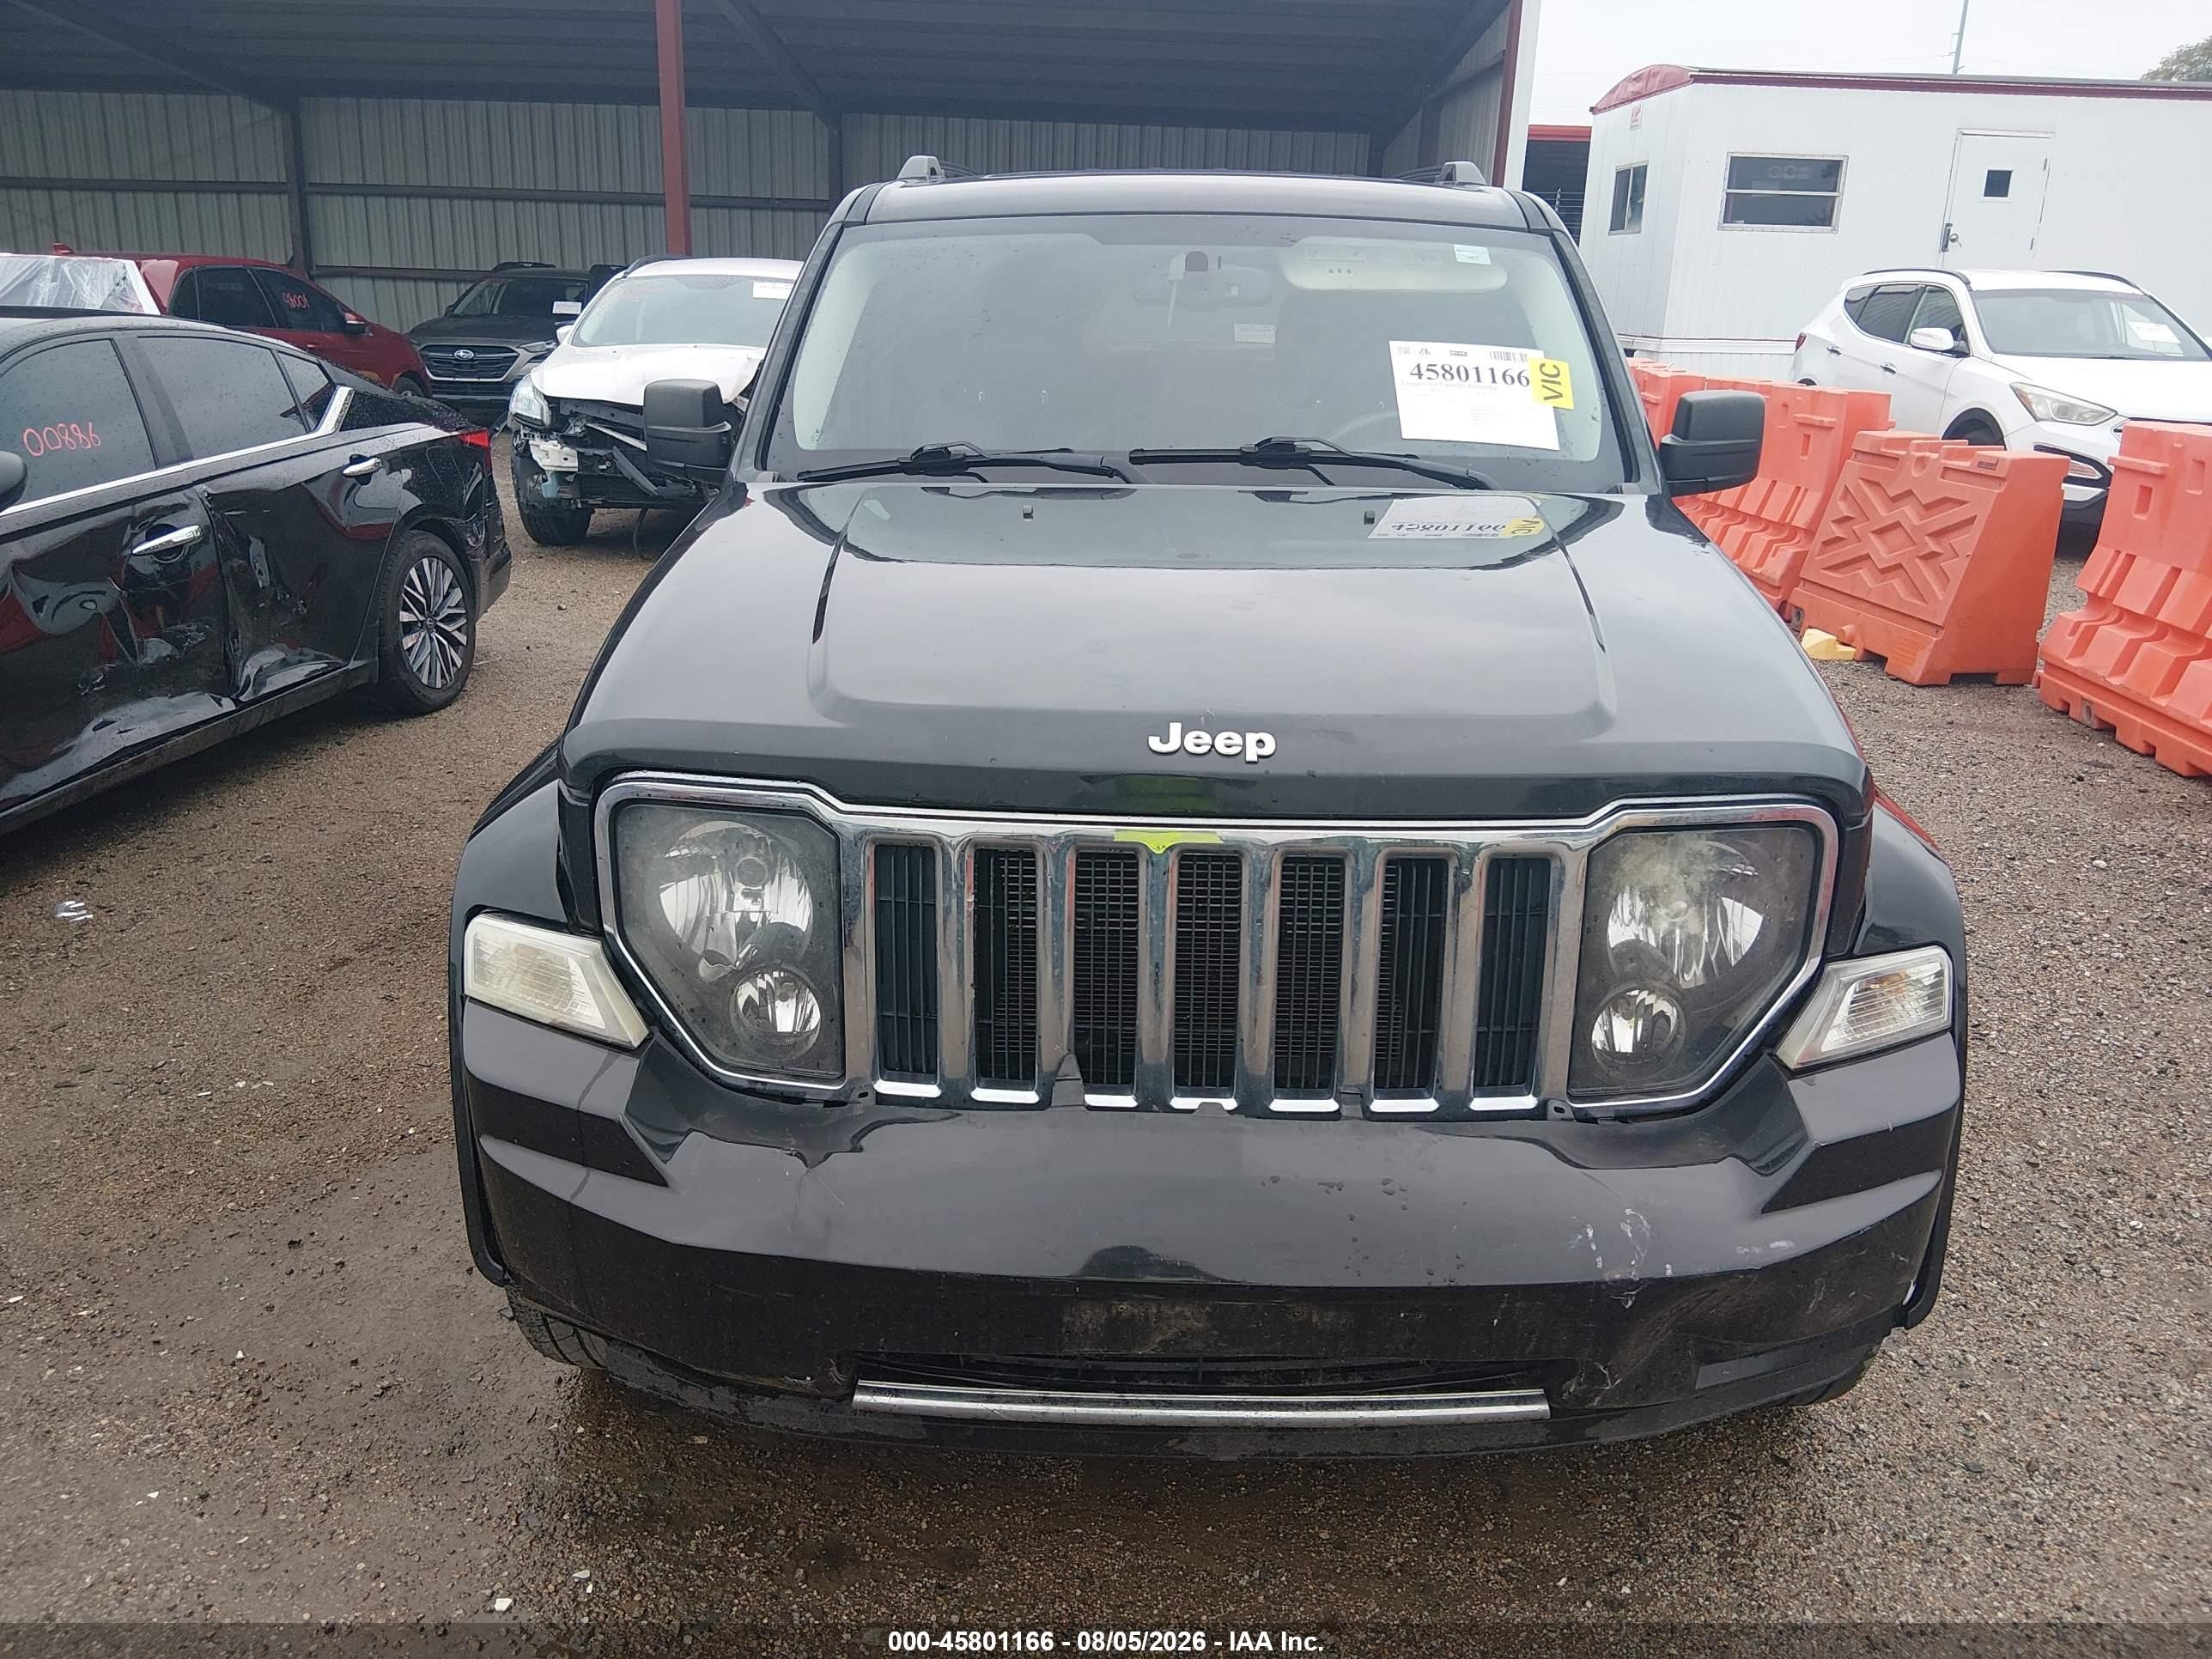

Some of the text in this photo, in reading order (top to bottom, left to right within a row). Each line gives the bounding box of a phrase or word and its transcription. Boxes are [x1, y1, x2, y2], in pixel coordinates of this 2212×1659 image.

[1410, 362, 1530, 386] 45801166
[1539, 362, 1563, 401] VIC
[22, 422, 101, 457] 00886
[1147, 721, 1277, 764] Jeep
